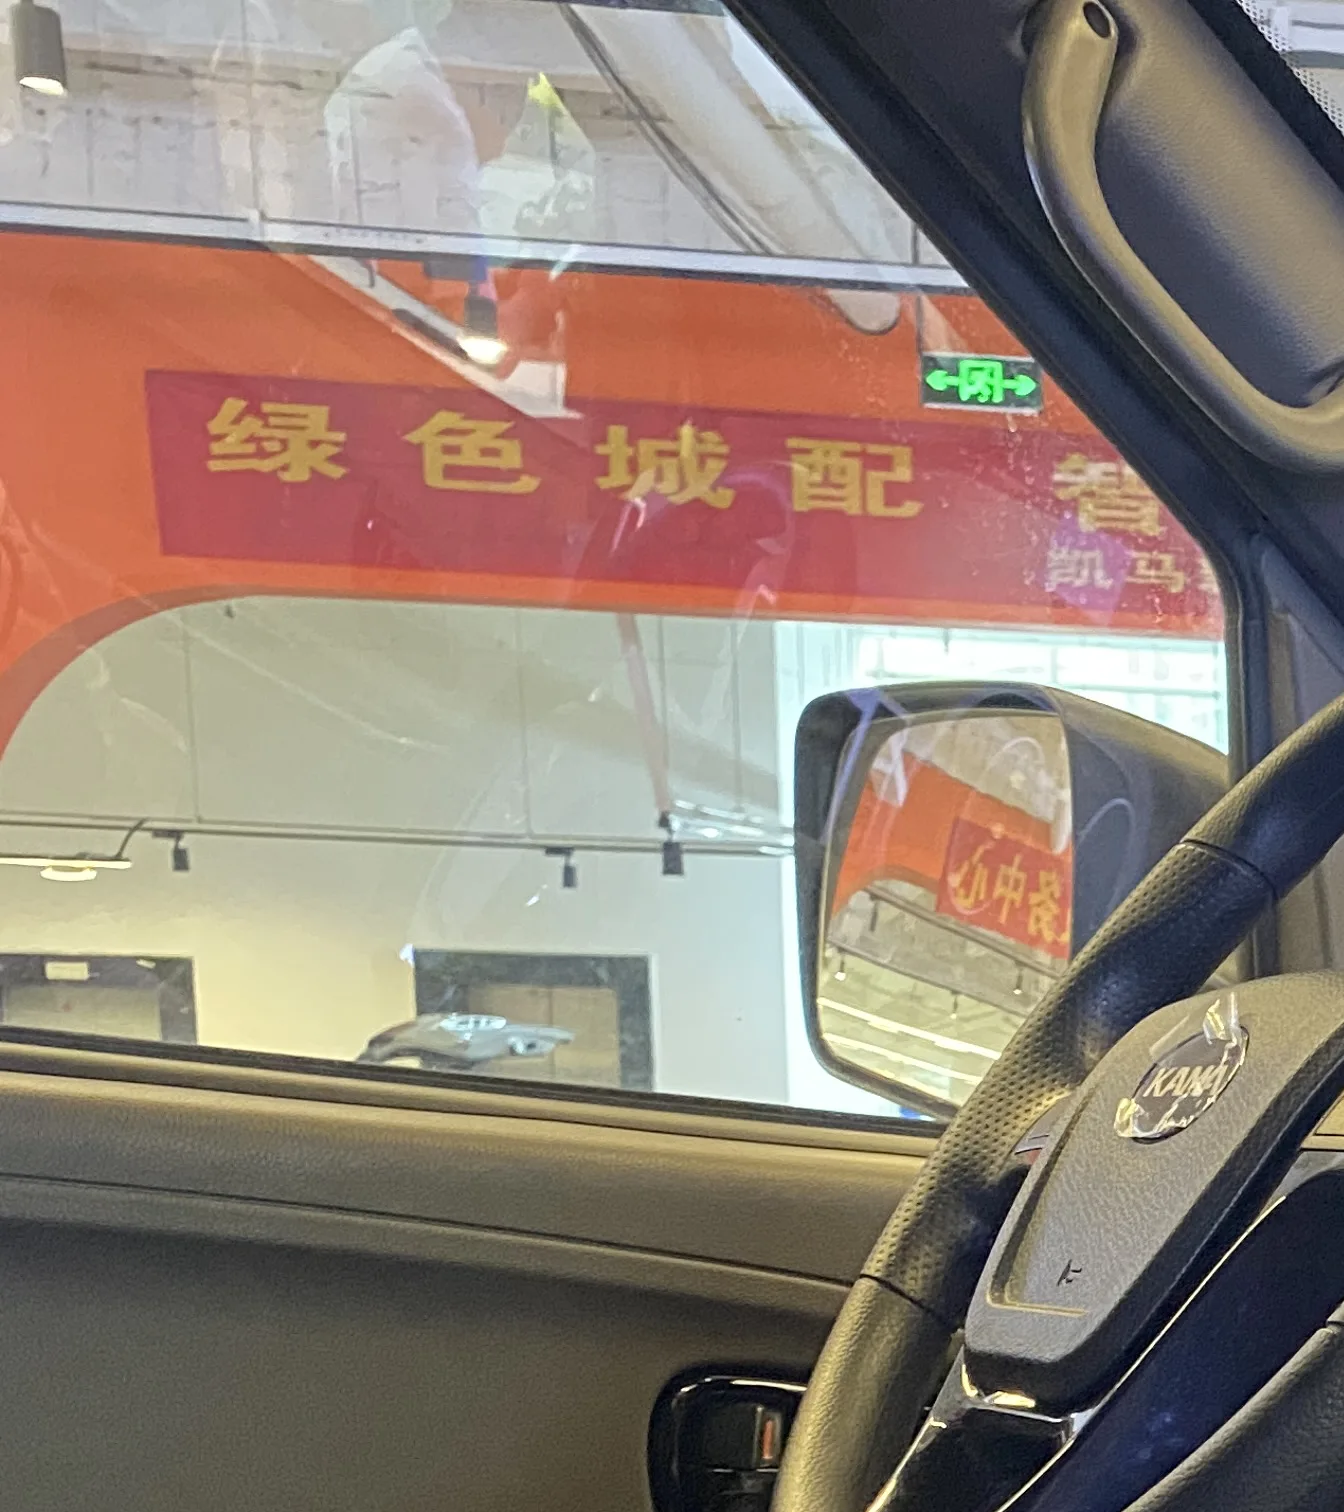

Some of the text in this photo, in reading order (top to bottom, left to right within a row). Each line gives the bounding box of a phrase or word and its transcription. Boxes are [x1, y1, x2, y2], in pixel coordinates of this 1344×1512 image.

[206, 397, 925, 518] 绿色城配
[1045, 540, 1220, 598] 凯马
[1142, 1063, 1230, 1098] KAMA
